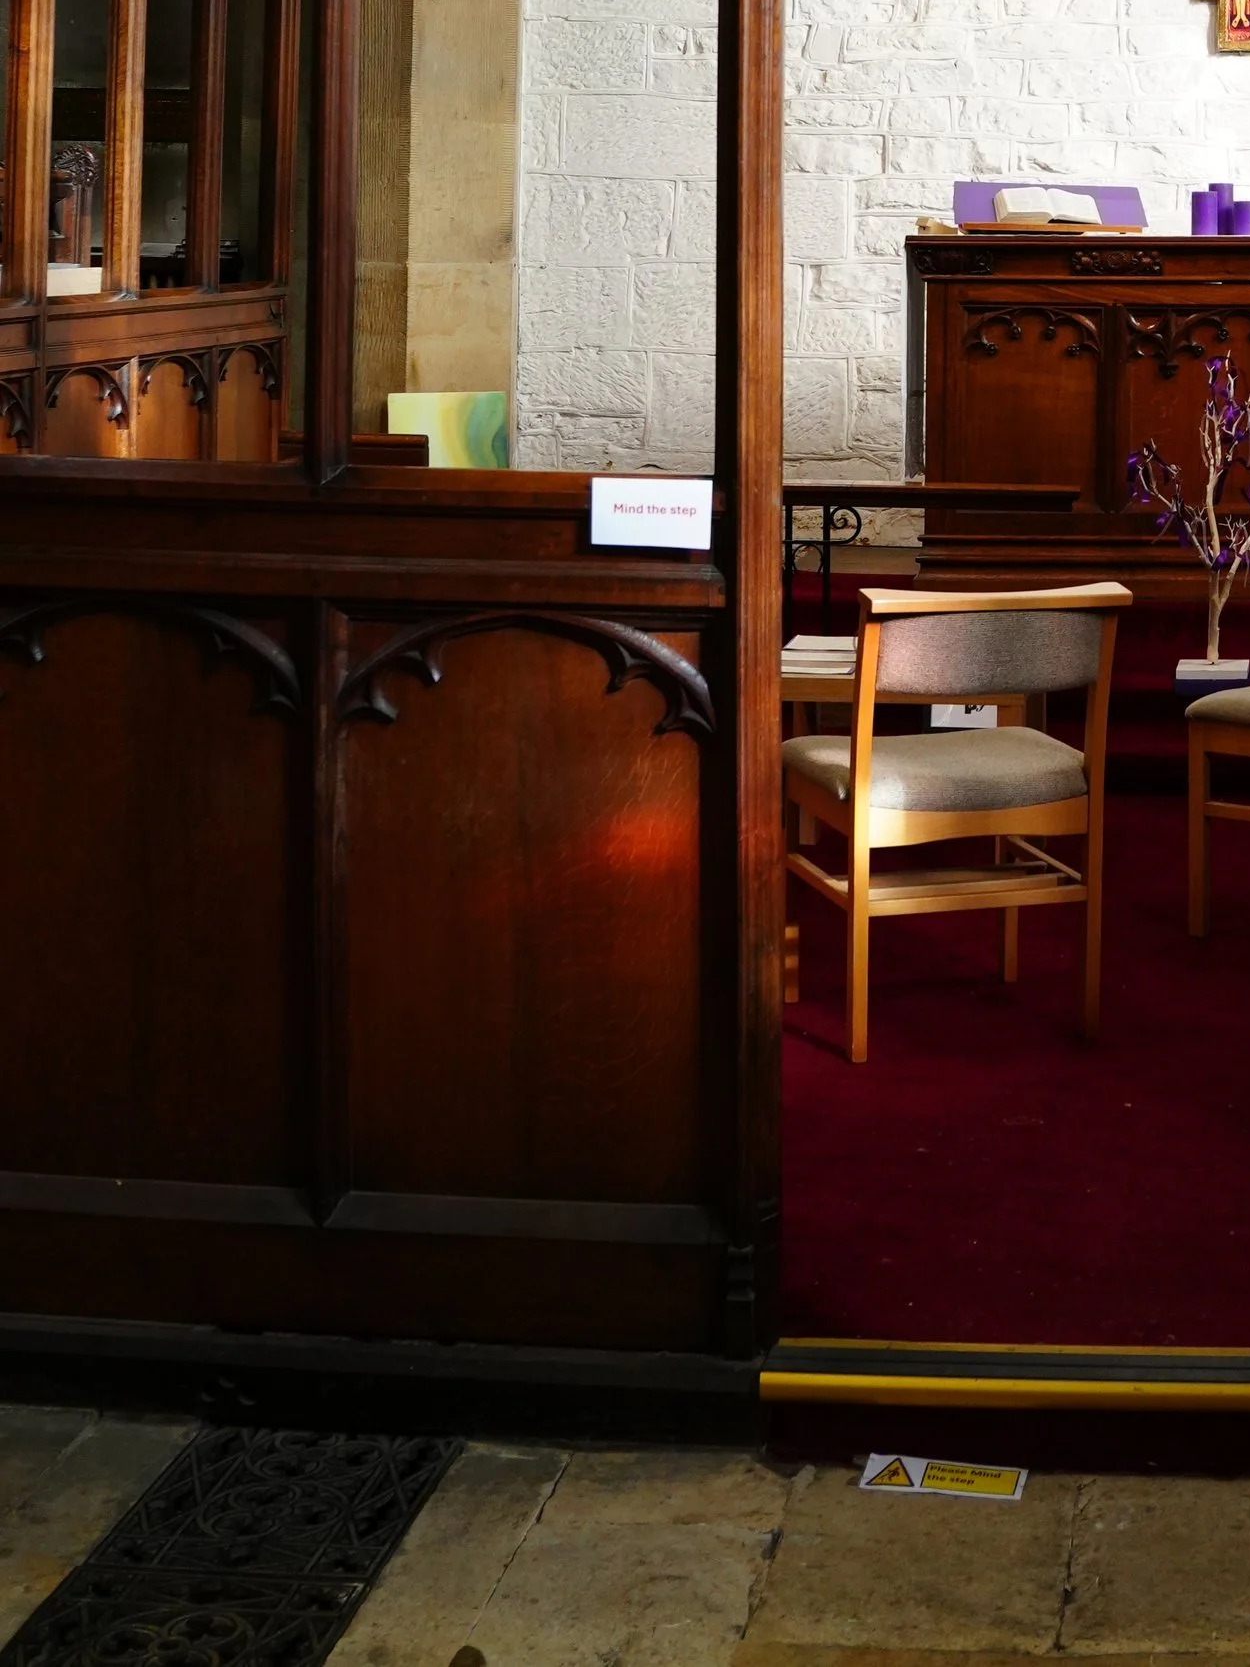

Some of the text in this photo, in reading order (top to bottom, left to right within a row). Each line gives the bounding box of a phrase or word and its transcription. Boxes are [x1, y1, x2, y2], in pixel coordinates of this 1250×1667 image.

[613, 503, 697, 517] Mind the step
[929, 1465, 1002, 1479] Please Mind
[927, 1474, 975, 1486] the step
